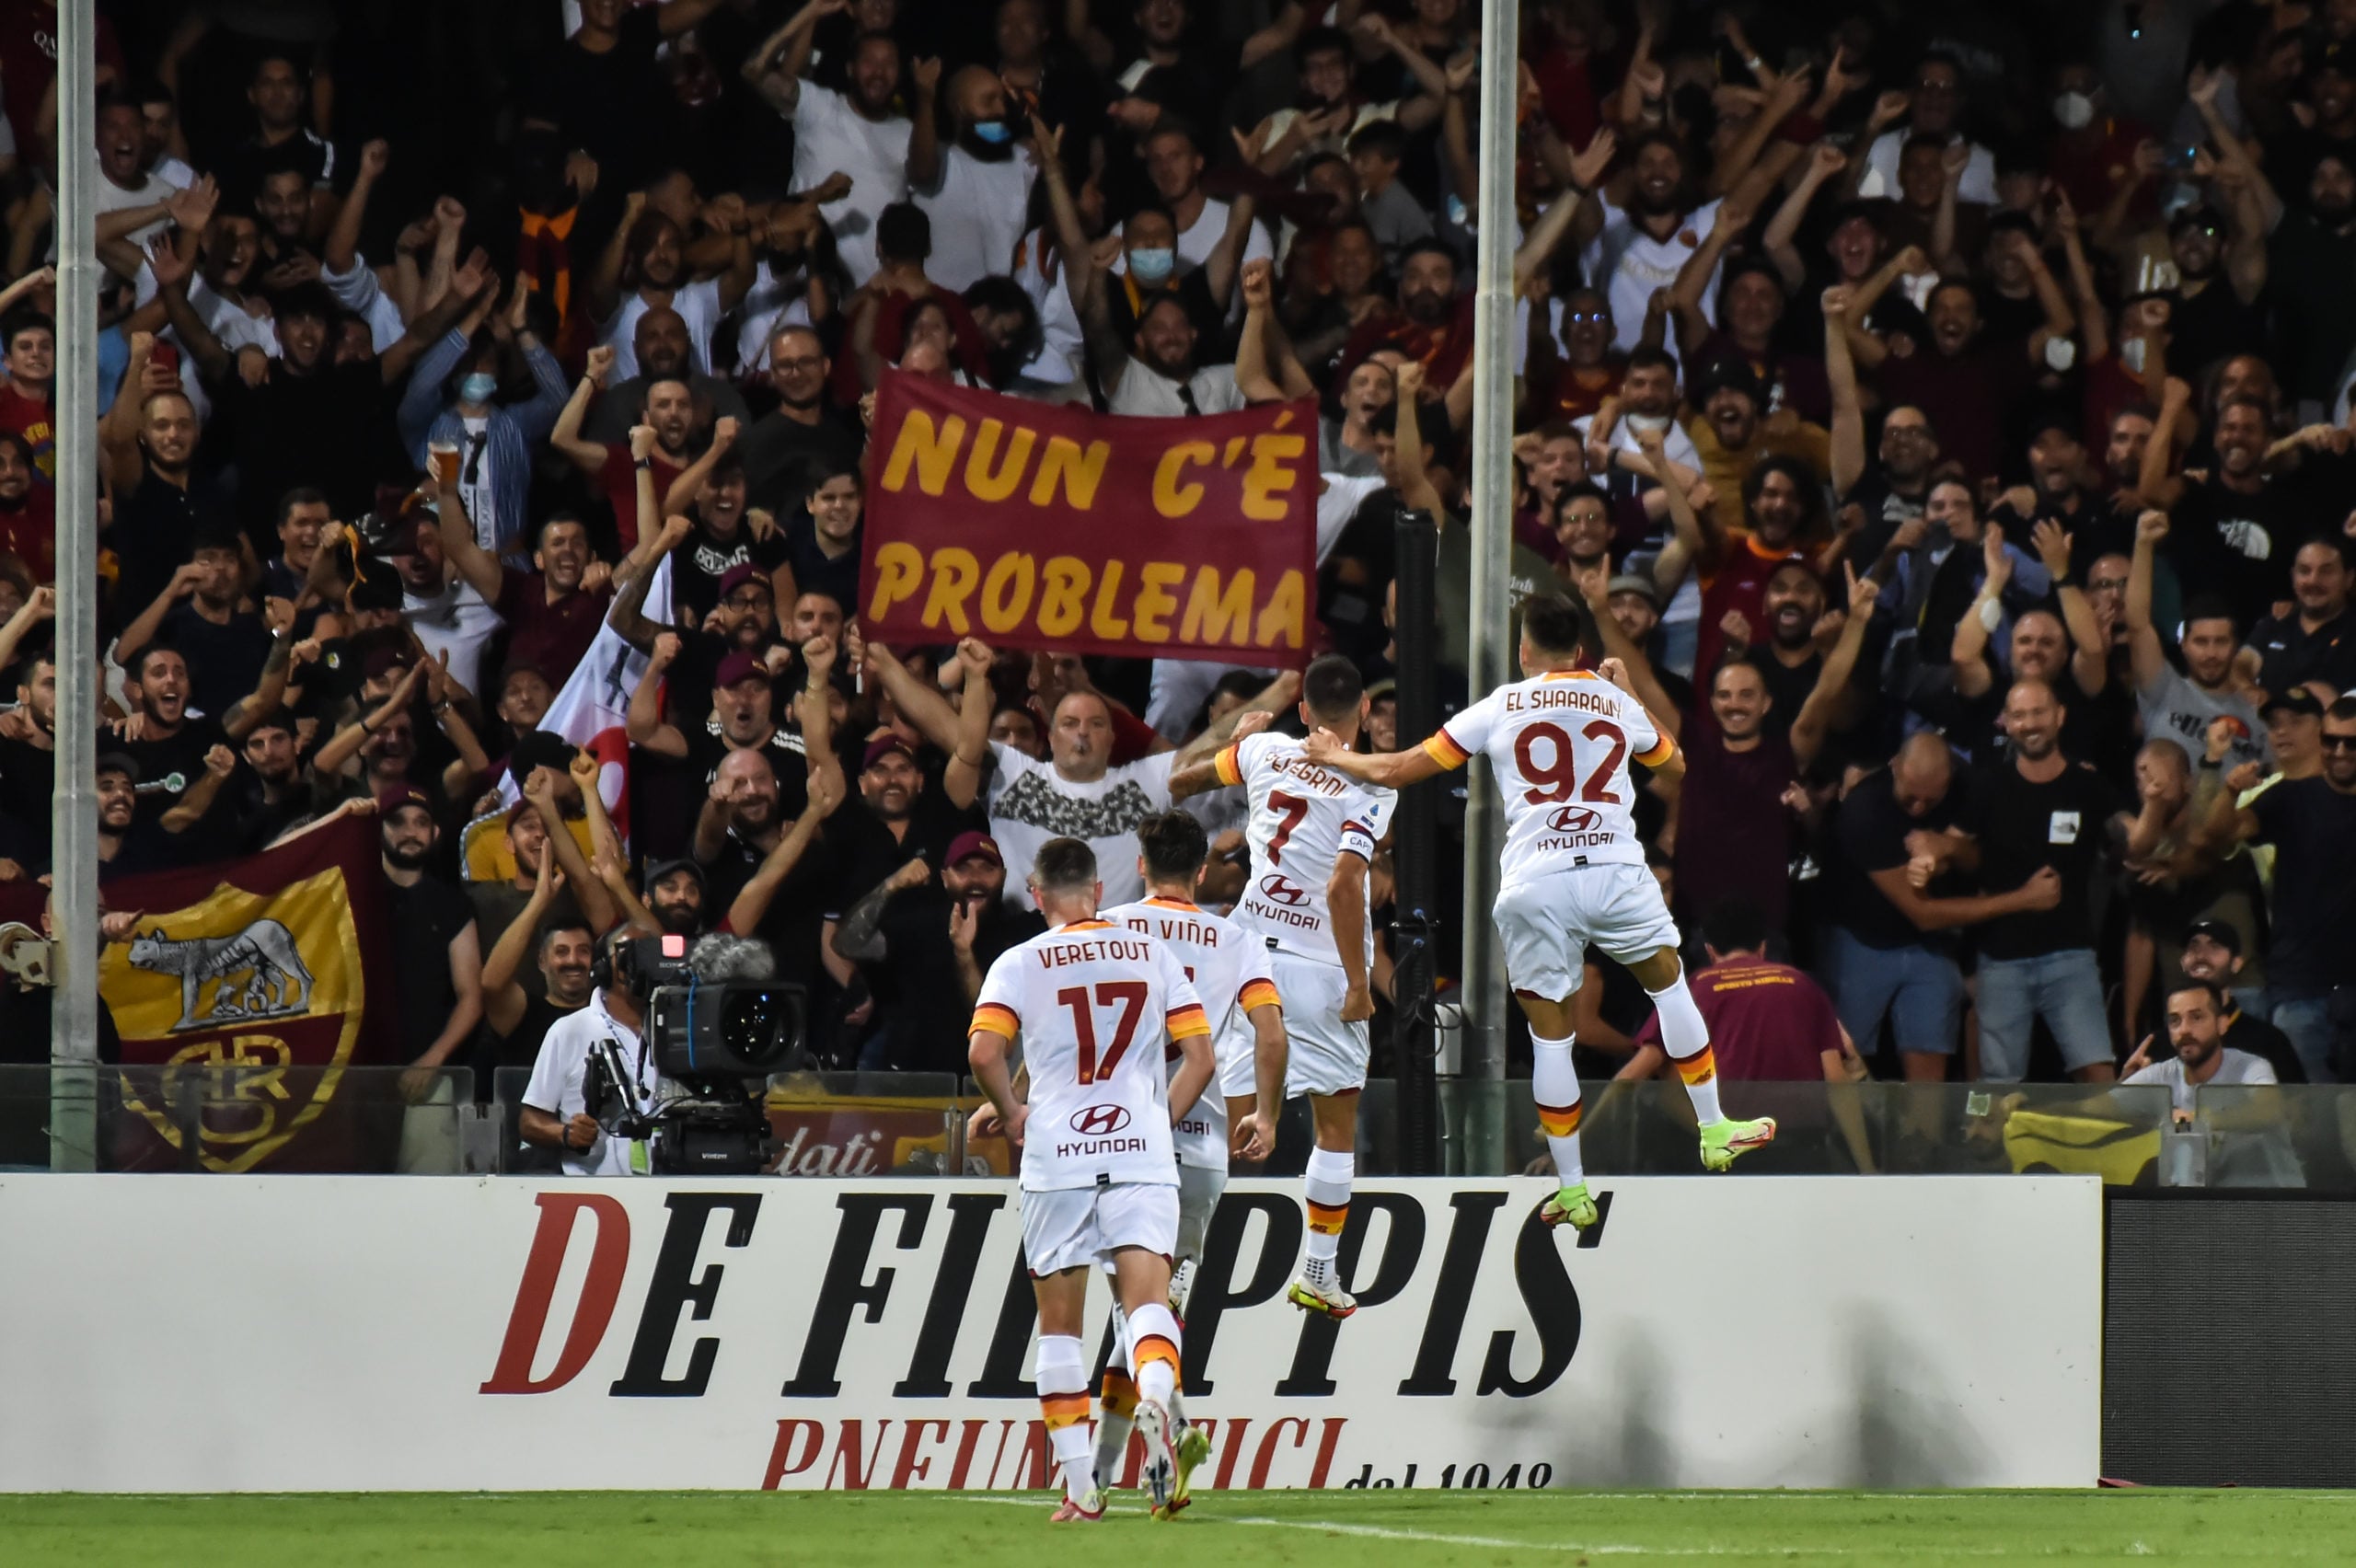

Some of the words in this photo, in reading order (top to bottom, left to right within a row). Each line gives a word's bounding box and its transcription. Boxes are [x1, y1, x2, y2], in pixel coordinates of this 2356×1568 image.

[881, 409, 1111, 510] NUN
[1152, 410, 1305, 520] C'É
[868, 542, 1305, 648] PROBLEMA
[1507, 692, 1524, 711] EL
[1530, 690, 1622, 720] SHAARAWY
[1514, 719, 1627, 805] 92
[1266, 790, 1308, 867] 7
[1538, 832, 1614, 852] HYUNDAI
[1160, 918, 1218, 948] VIÑA
[1245, 898, 1321, 931] HYUNDAI
[1038, 940, 1150, 969] VERETOUT
[1057, 981, 1149, 1086] 17
[1057, 1138, 1147, 1158] HYUNDAI
[479, 1192, 763, 1397] DE
[780, 1192, 1613, 1398] FILPPIS
